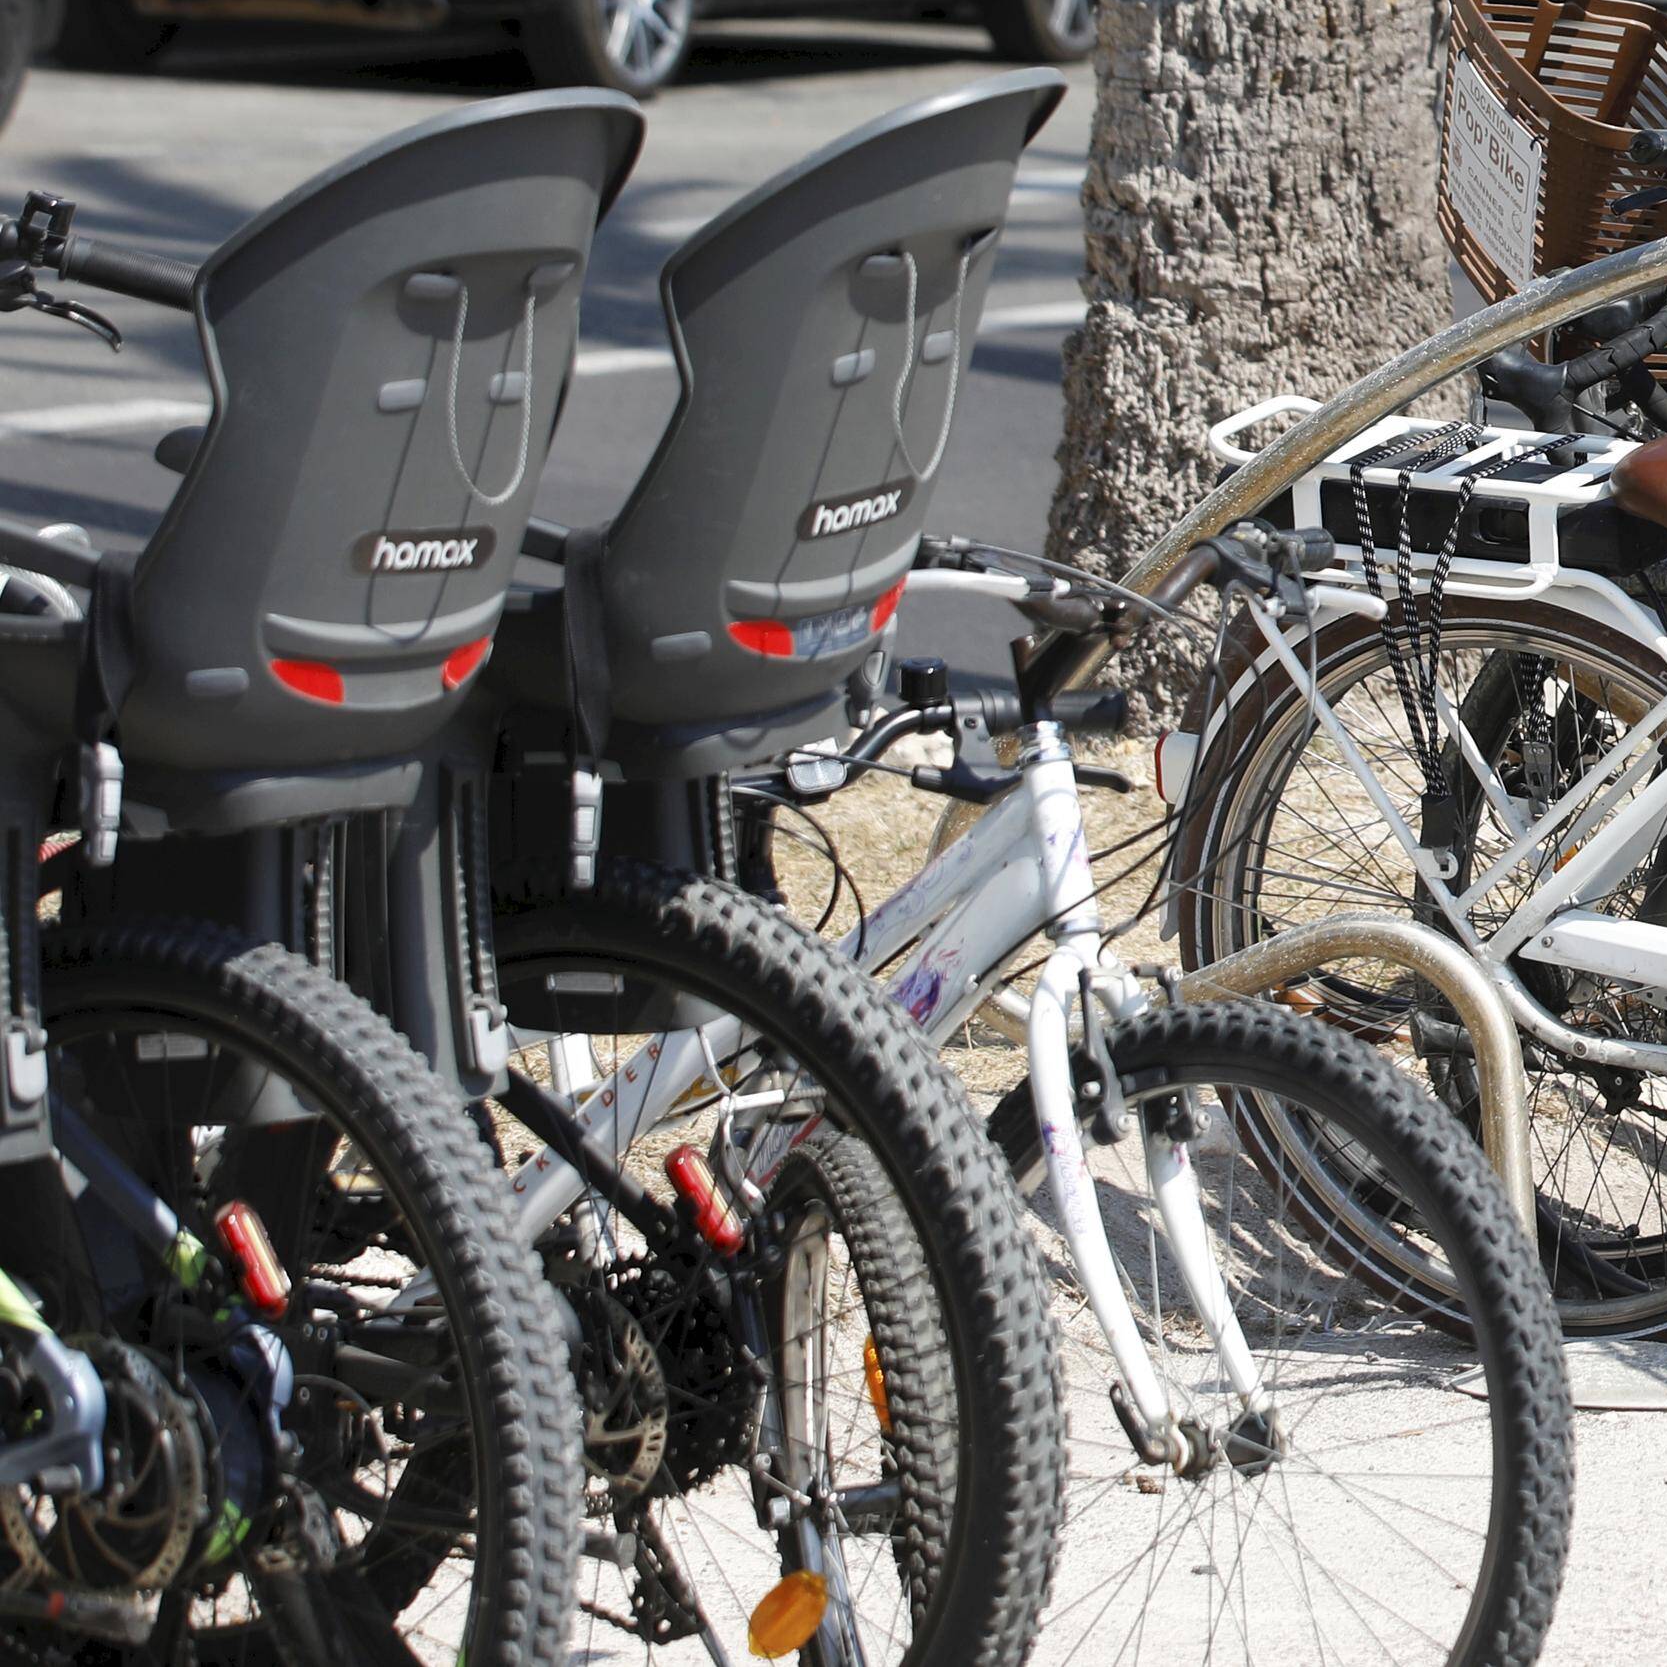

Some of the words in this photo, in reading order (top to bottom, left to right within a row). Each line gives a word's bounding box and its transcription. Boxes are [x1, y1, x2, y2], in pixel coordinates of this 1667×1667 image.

[1468, 77, 1516, 145] LOCATION
[1456, 88, 1526, 194] Pop'Bike
[1467, 164, 1505, 217] CANNES
[812, 487, 901, 537] hamax
[372, 537, 478, 571] hamax
